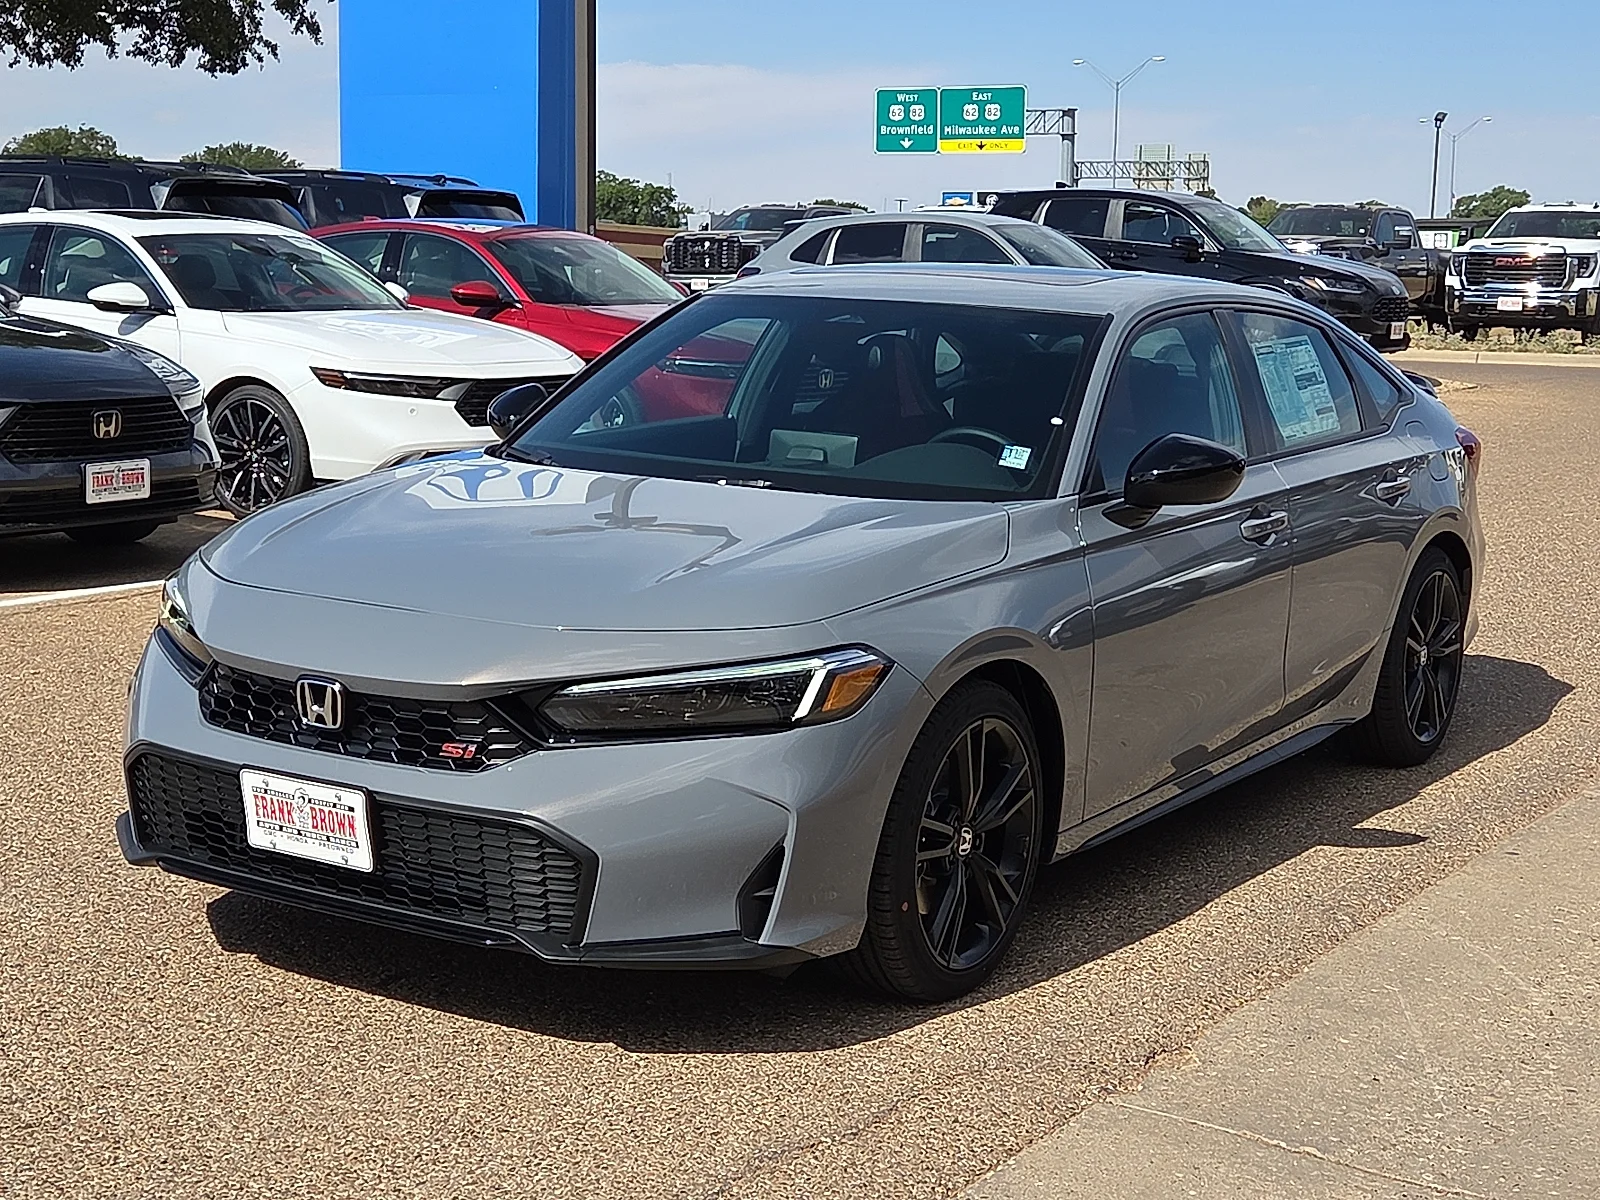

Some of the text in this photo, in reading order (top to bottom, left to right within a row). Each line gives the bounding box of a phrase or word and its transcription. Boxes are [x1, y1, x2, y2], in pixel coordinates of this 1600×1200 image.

[972, 92, 992, 101] EAST
[891, 108, 923, 117] 62 82
[965, 107, 998, 117] 62 82
[880, 125, 934, 135] Brownfield
[944, 125, 1020, 135] Milwaukee Ave
[253, 794, 296, 827] FRANK
[309, 806, 358, 840] BROWN
